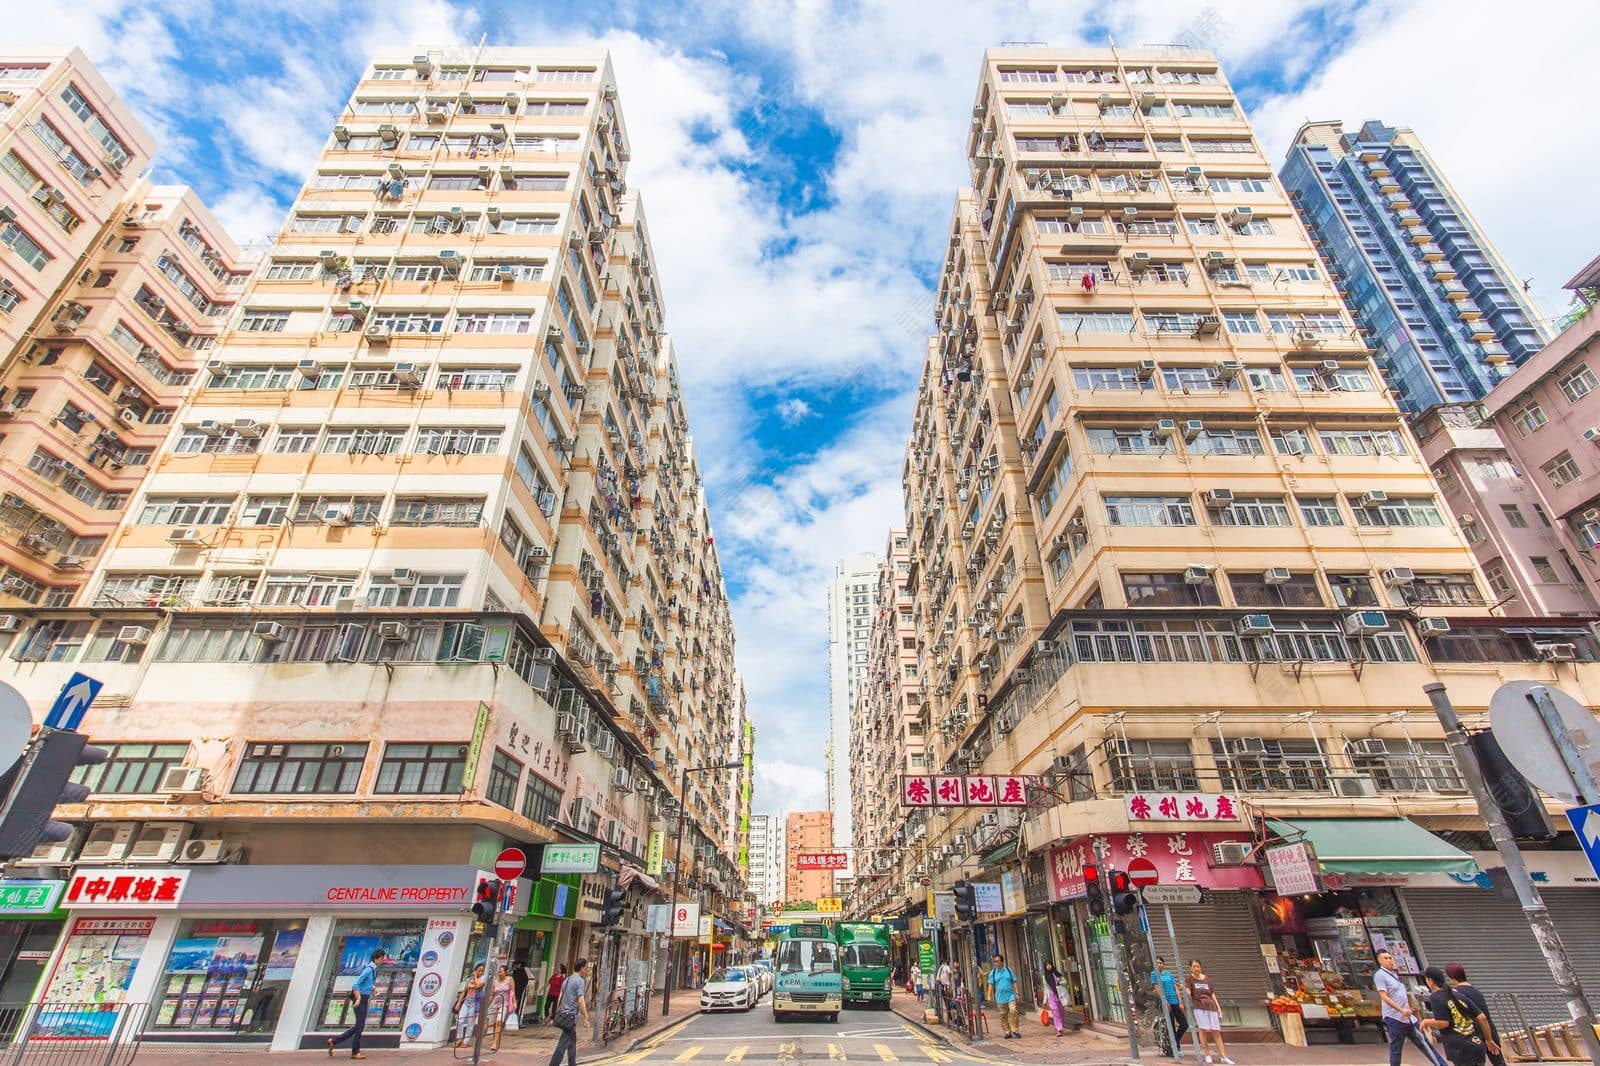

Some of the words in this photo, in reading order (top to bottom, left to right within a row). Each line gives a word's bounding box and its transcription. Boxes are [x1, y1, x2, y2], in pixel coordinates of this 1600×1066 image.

[907, 778, 1025, 803] 榮利地產
[1130, 795, 1238, 819] 榮利地產
[84, 876, 182, 901] 中原地產
[327, 887, 398, 901] CENTALINE
[400, 887, 468, 901] PROPERTY
